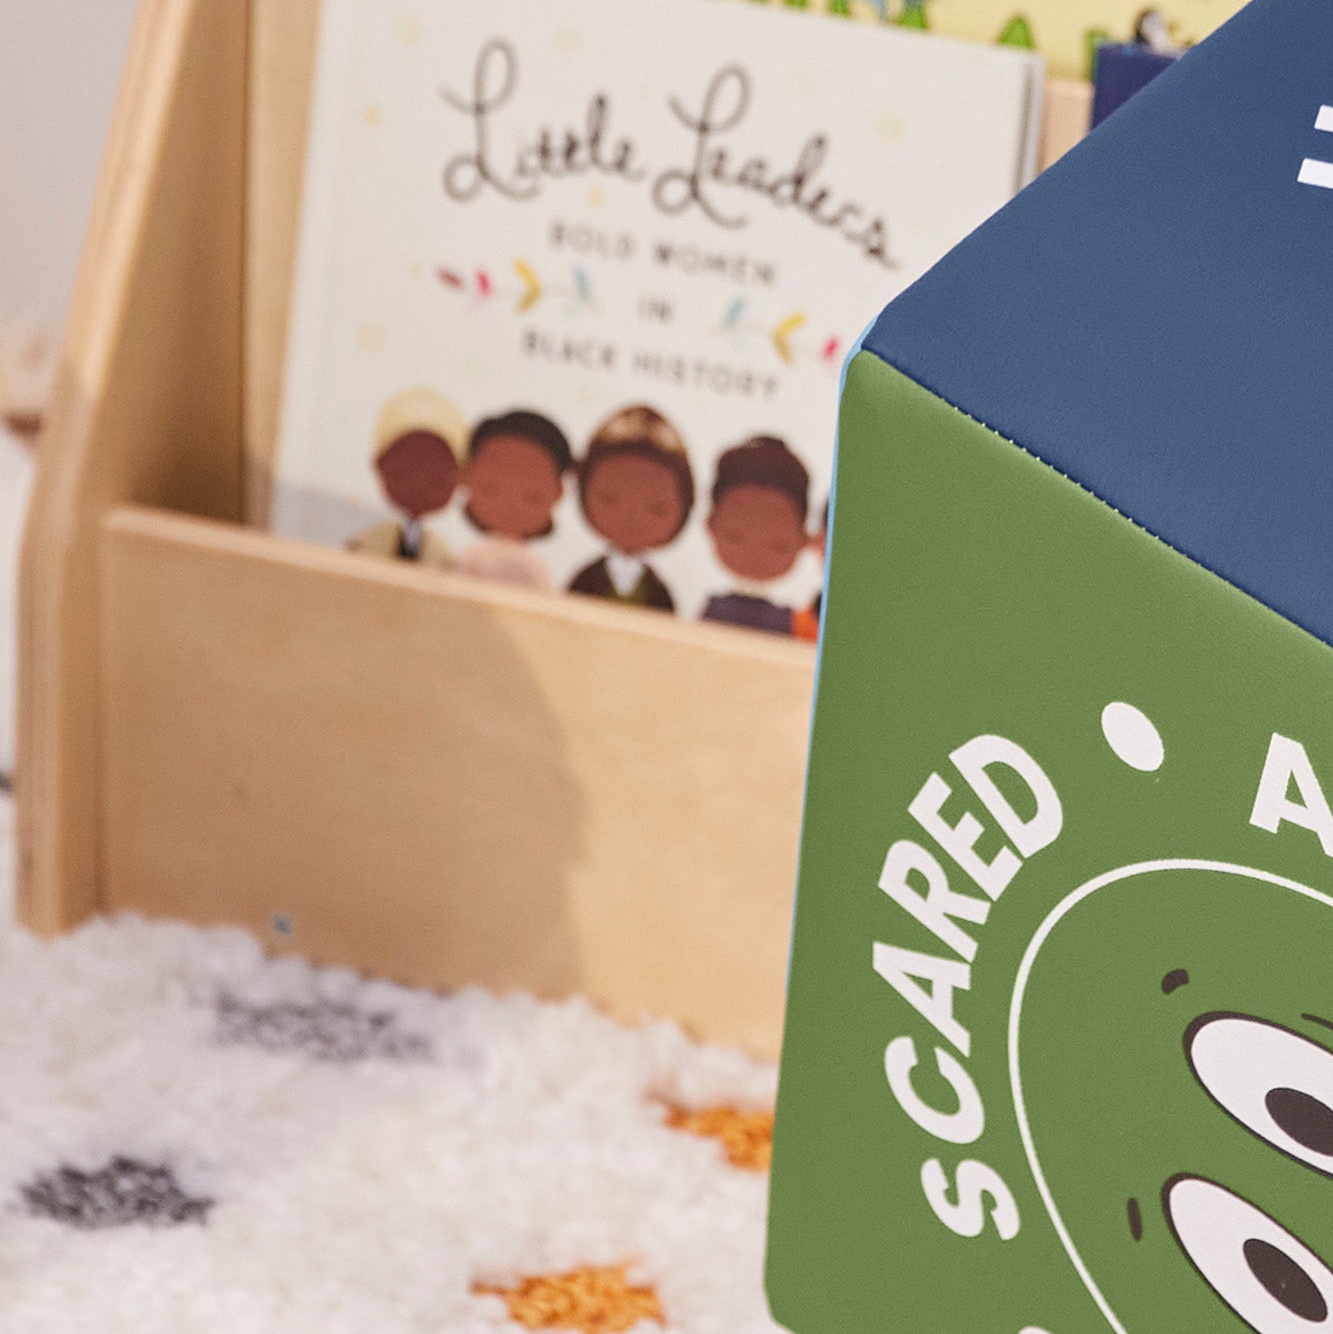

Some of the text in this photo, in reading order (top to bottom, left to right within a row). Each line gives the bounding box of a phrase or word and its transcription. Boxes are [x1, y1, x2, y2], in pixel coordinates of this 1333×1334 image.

[438, 37, 902, 272] Little Leaders
[549, 219, 777, 287] BOLD WOMEN
[638, 296, 672, 324] IN
[521, 326, 780, 399] BLACK HISTORY
[872, 732, 1066, 1242] SCARED
